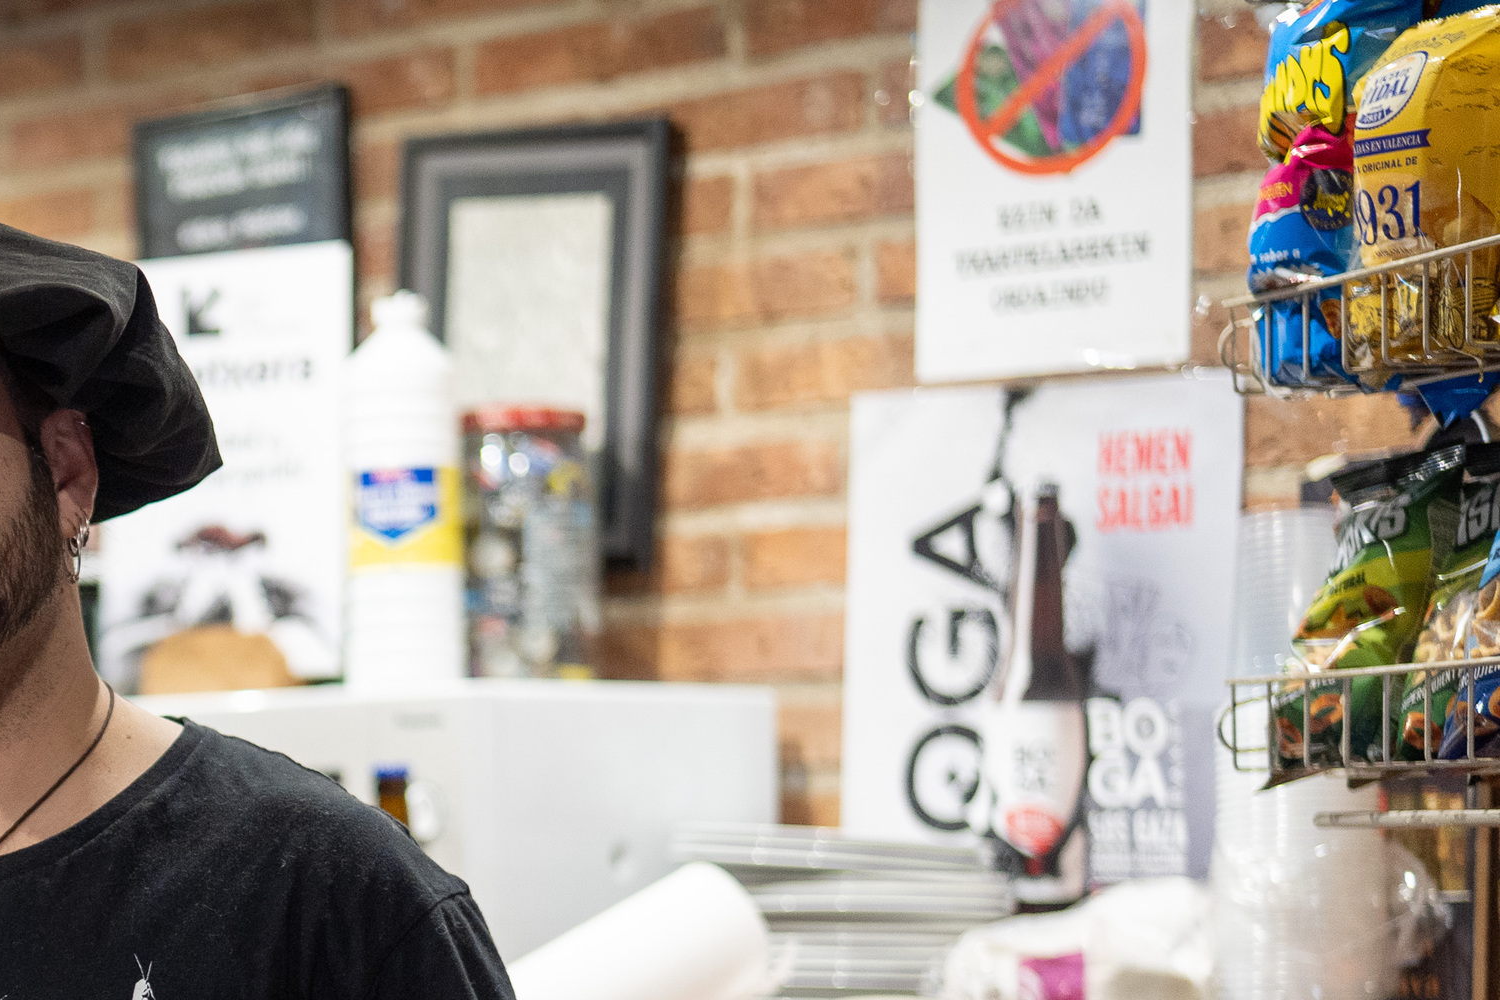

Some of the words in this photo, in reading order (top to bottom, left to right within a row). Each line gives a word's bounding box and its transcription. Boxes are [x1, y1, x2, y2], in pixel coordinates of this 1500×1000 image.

[1381, 134, 1421, 150] VALENCIA
[1362, 158, 1402, 173] ORIGINAL
[1405, 156, 1417, 166] DE
[1097, 430, 1191, 473] HEMEN
[1097, 484, 1193, 531] SALGAI
